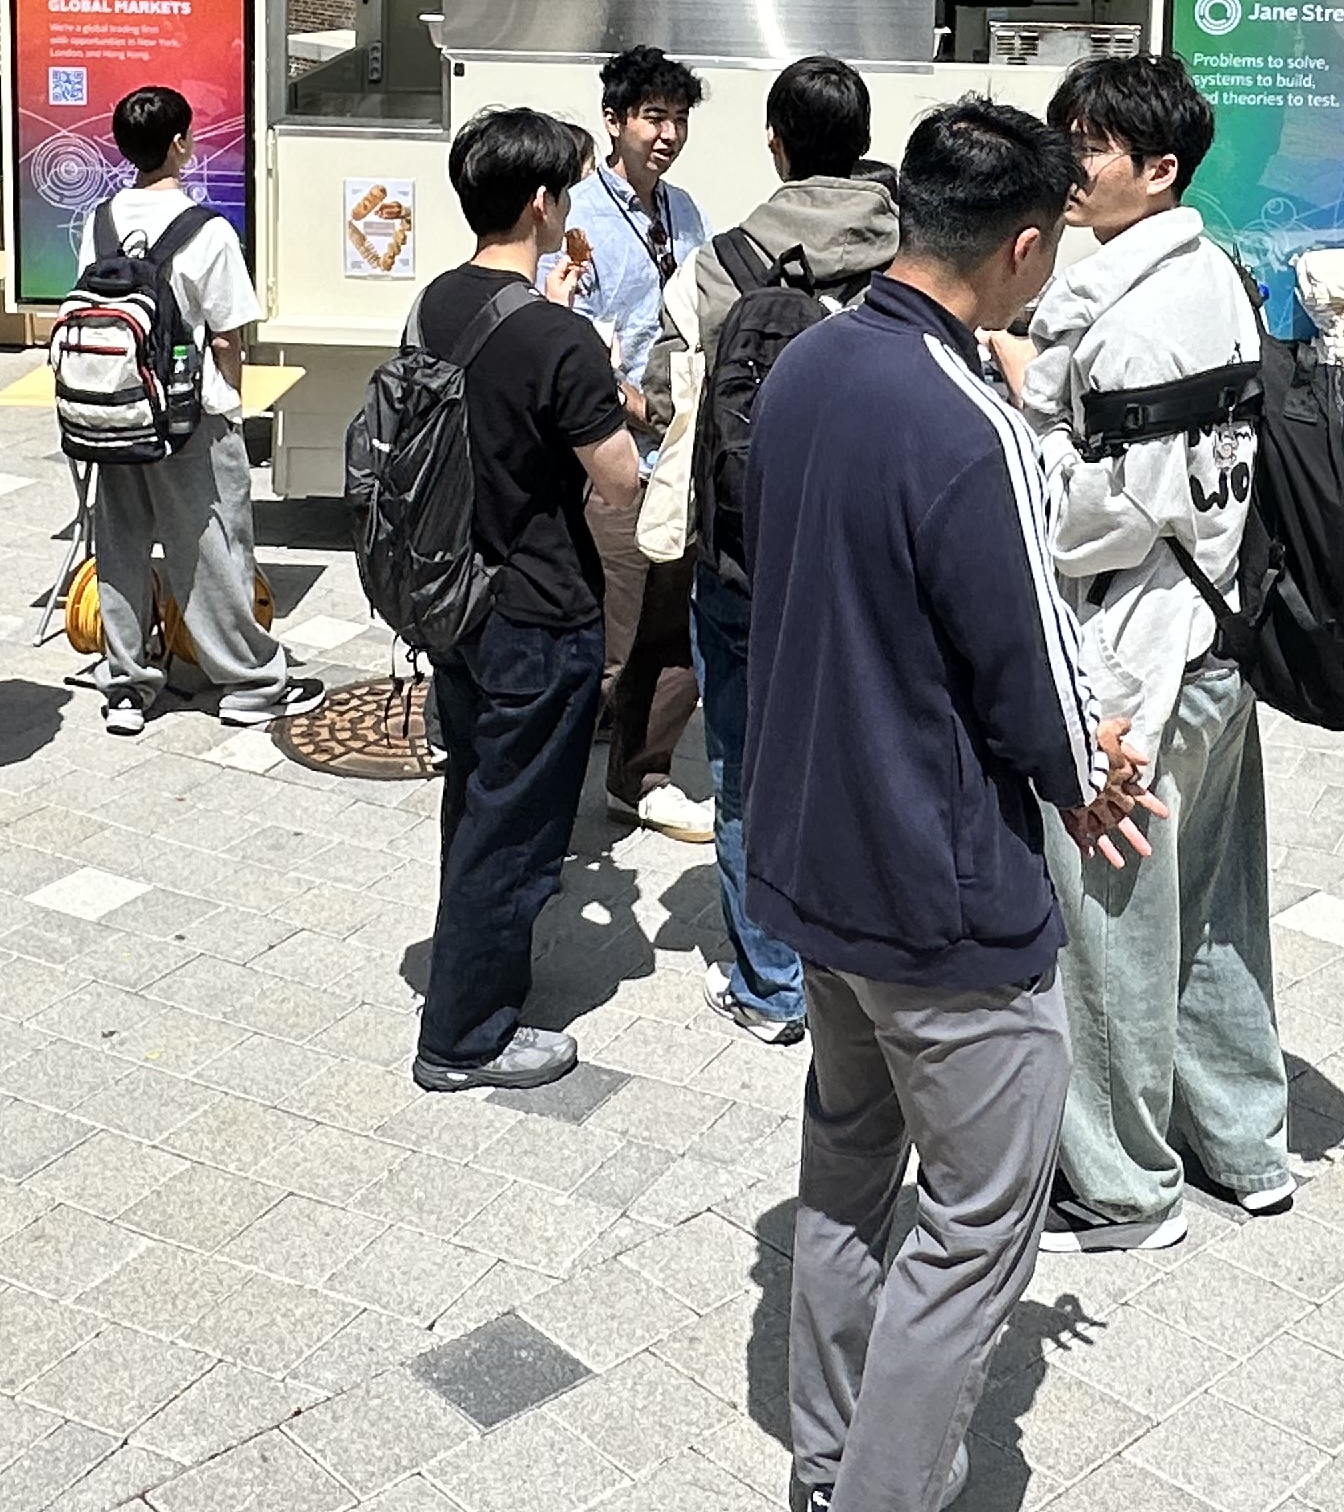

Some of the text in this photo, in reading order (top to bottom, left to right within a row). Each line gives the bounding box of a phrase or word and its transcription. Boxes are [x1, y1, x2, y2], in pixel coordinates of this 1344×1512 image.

[114, 1, 192, 15] MARKETS
[1247, 3, 1297, 21] Jane
[1193, 52, 1330, 72] Problems to solve,
[1193, 73, 1316, 90] systems to build,
[1222, 91, 1284, 106] theories
[1286, 94, 1304, 106] to
[1307, 94, 1341, 107] test.
